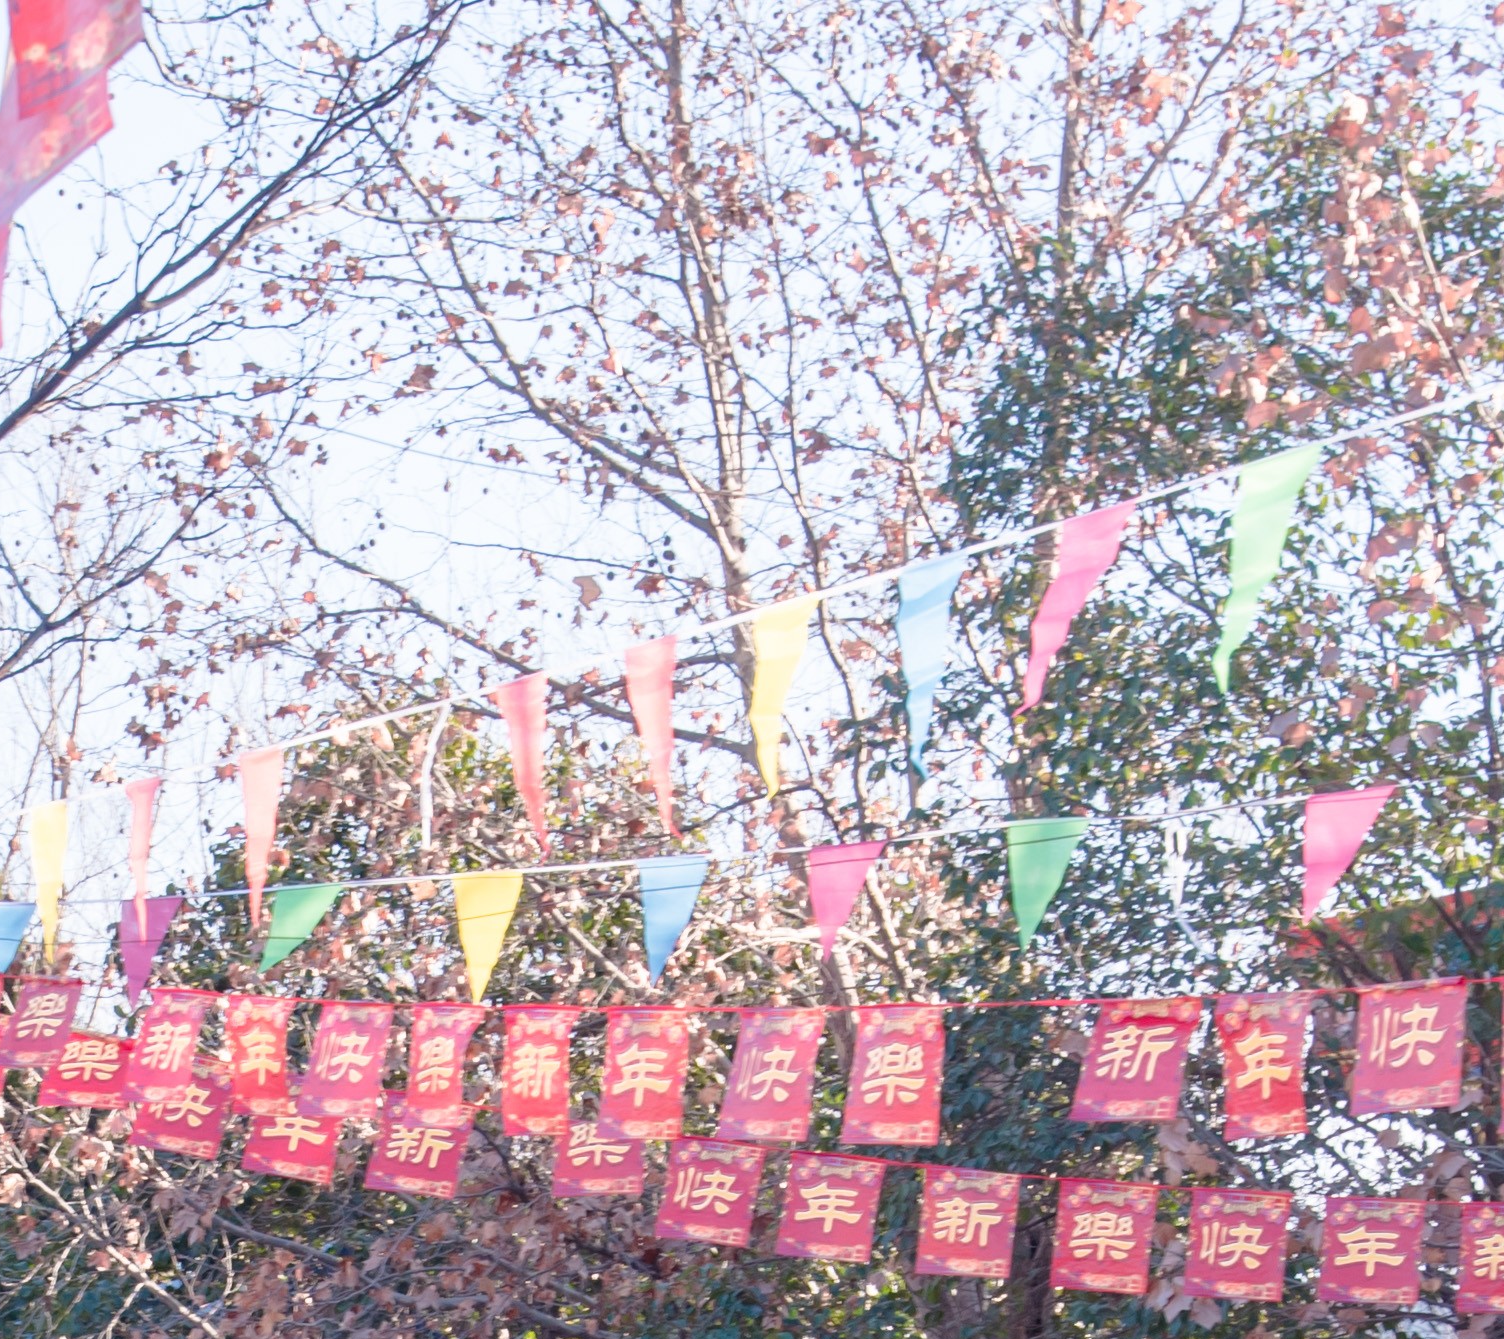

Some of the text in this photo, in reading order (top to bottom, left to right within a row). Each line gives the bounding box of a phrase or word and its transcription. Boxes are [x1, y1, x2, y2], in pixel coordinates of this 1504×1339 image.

[14, 991, 69, 1039] 樂
[1367, 1002, 1447, 1068] 快
[58, 1039, 121, 1082] 樂
[140, 1021, 191, 1072] 新
[237, 1028, 281, 1085] 年
[318, 1030, 373, 1084] 快
[417, 1036, 457, 1094] 樂
[510, 1043, 562, 1100] 新
[739, 1043, 800, 1102] 快
[1094, 1024, 1178, 1082] 新
[1234, 1028, 1292, 1099] 年
[610, 1042, 674, 1107] 年
[860, 1042, 927, 1106] 樂
[385, 1124, 456, 1169] 新
[672, 1165, 741, 1216] 快
[793, 1180, 865, 1233] 年
[932, 1196, 1003, 1248] 新
[1067, 1210, 1138, 1262] 樂
[1198, 1220, 1273, 1271] 快
[1333, 1225, 1406, 1277] 年
